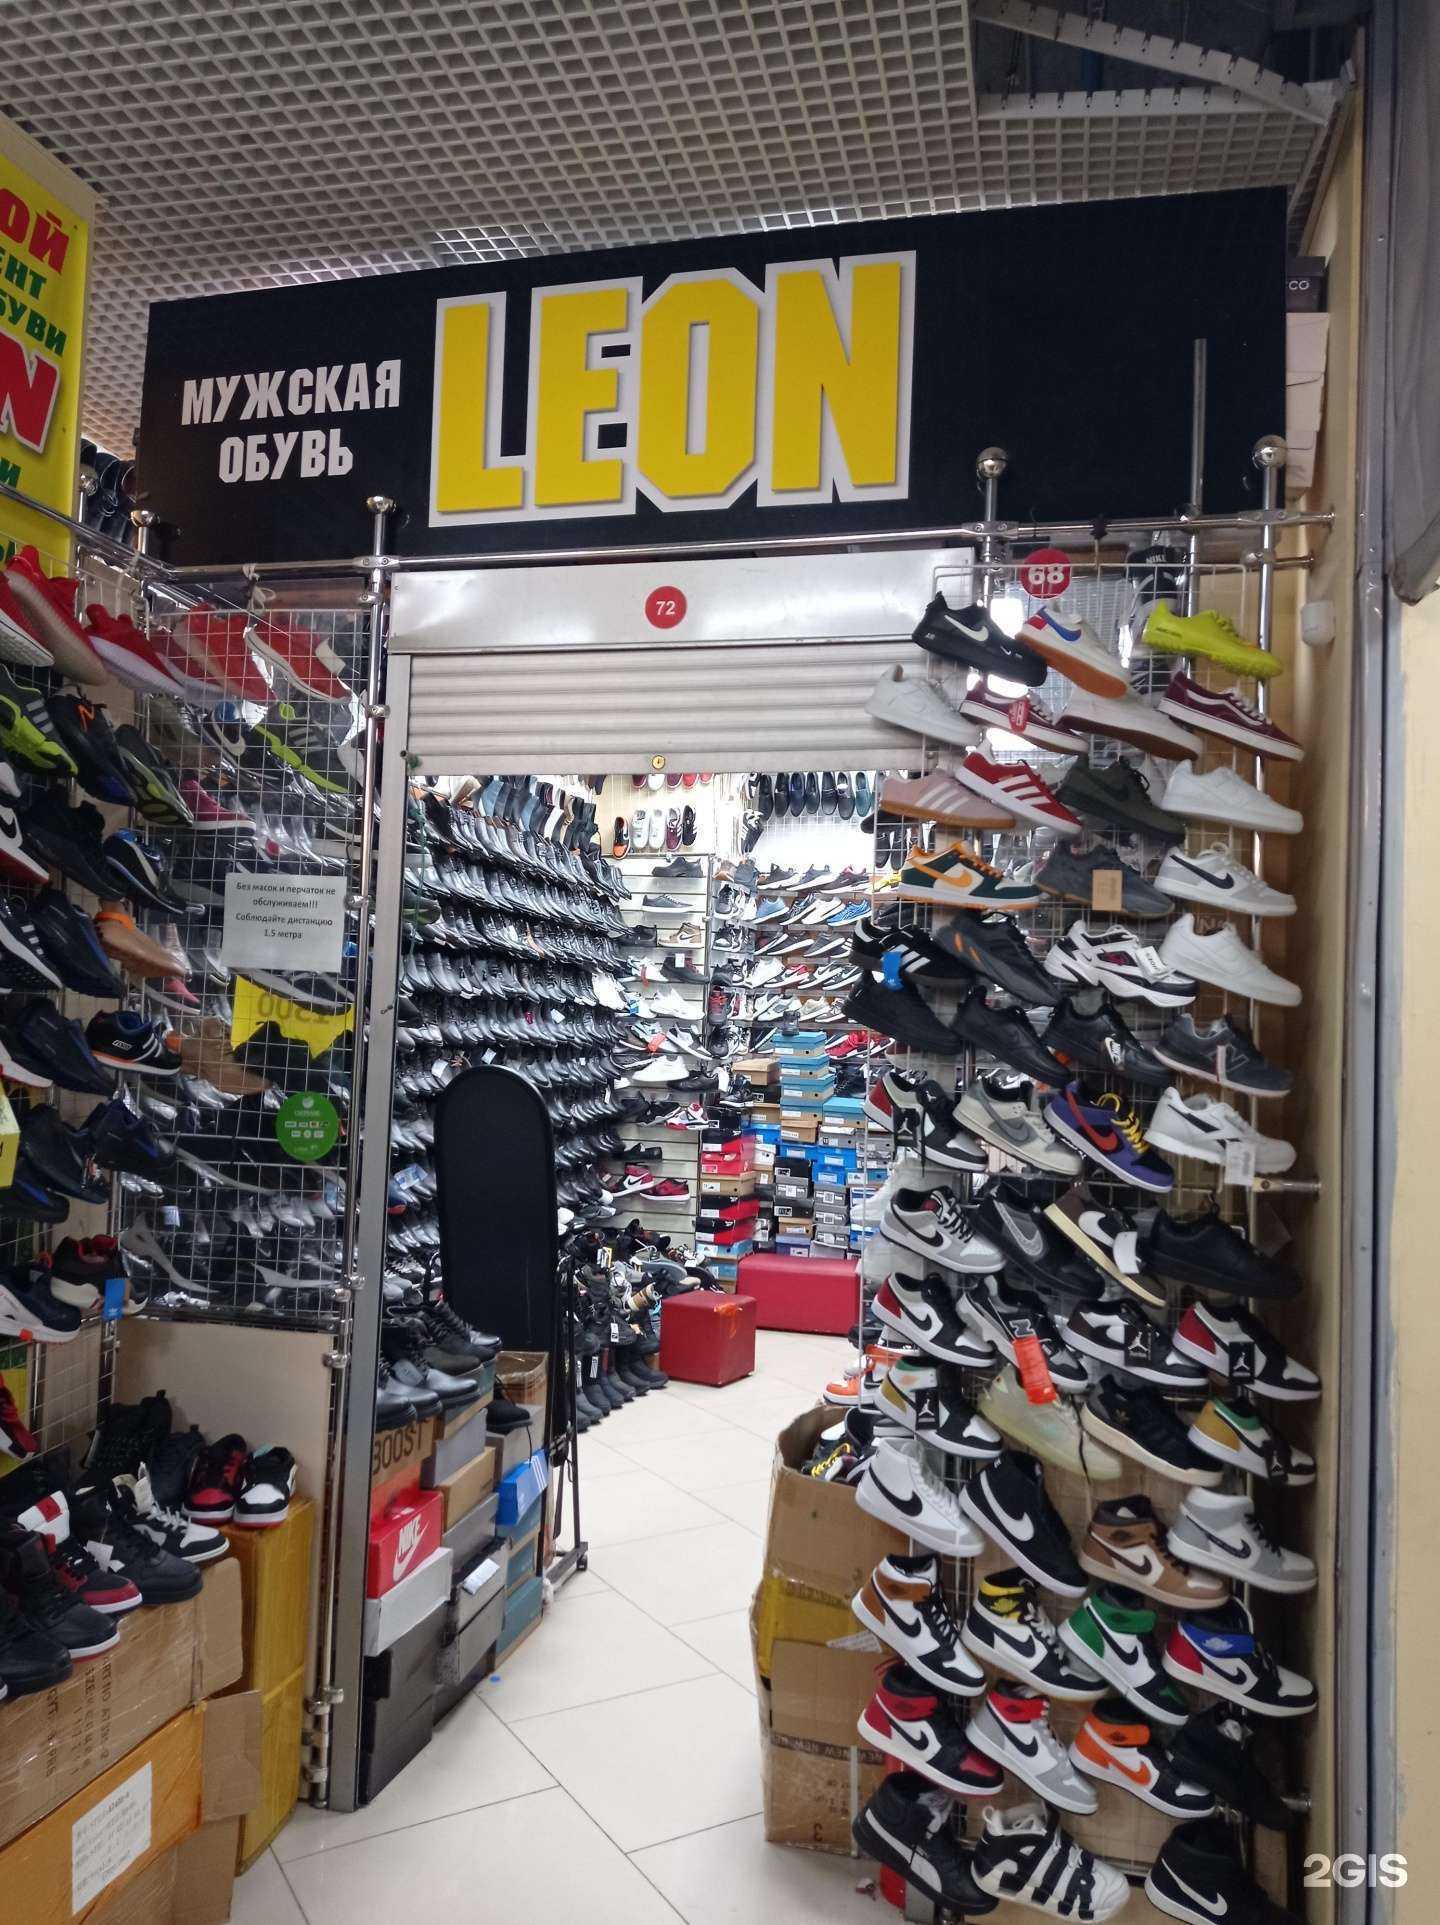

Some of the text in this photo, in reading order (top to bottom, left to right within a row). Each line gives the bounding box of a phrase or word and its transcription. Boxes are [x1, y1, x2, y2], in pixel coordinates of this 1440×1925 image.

[181, 359, 401, 425] МУЖСКАЯ
[430, 252, 914, 524] LEON
[218, 428, 353, 484] ОБУВЬ
[1028, 563, 1065, 585] 68
[656, 600, 675, 616] 72
[236, 882, 250, 890] Без
[286, 886, 323, 896] перчаток
[253, 897, 318, 909] обслуживаем!!!
[236, 912, 333, 927] Соблюдайте дистанцию
[277, 930, 302, 940] метра
[398, 1513, 422, 1558] NIKE
